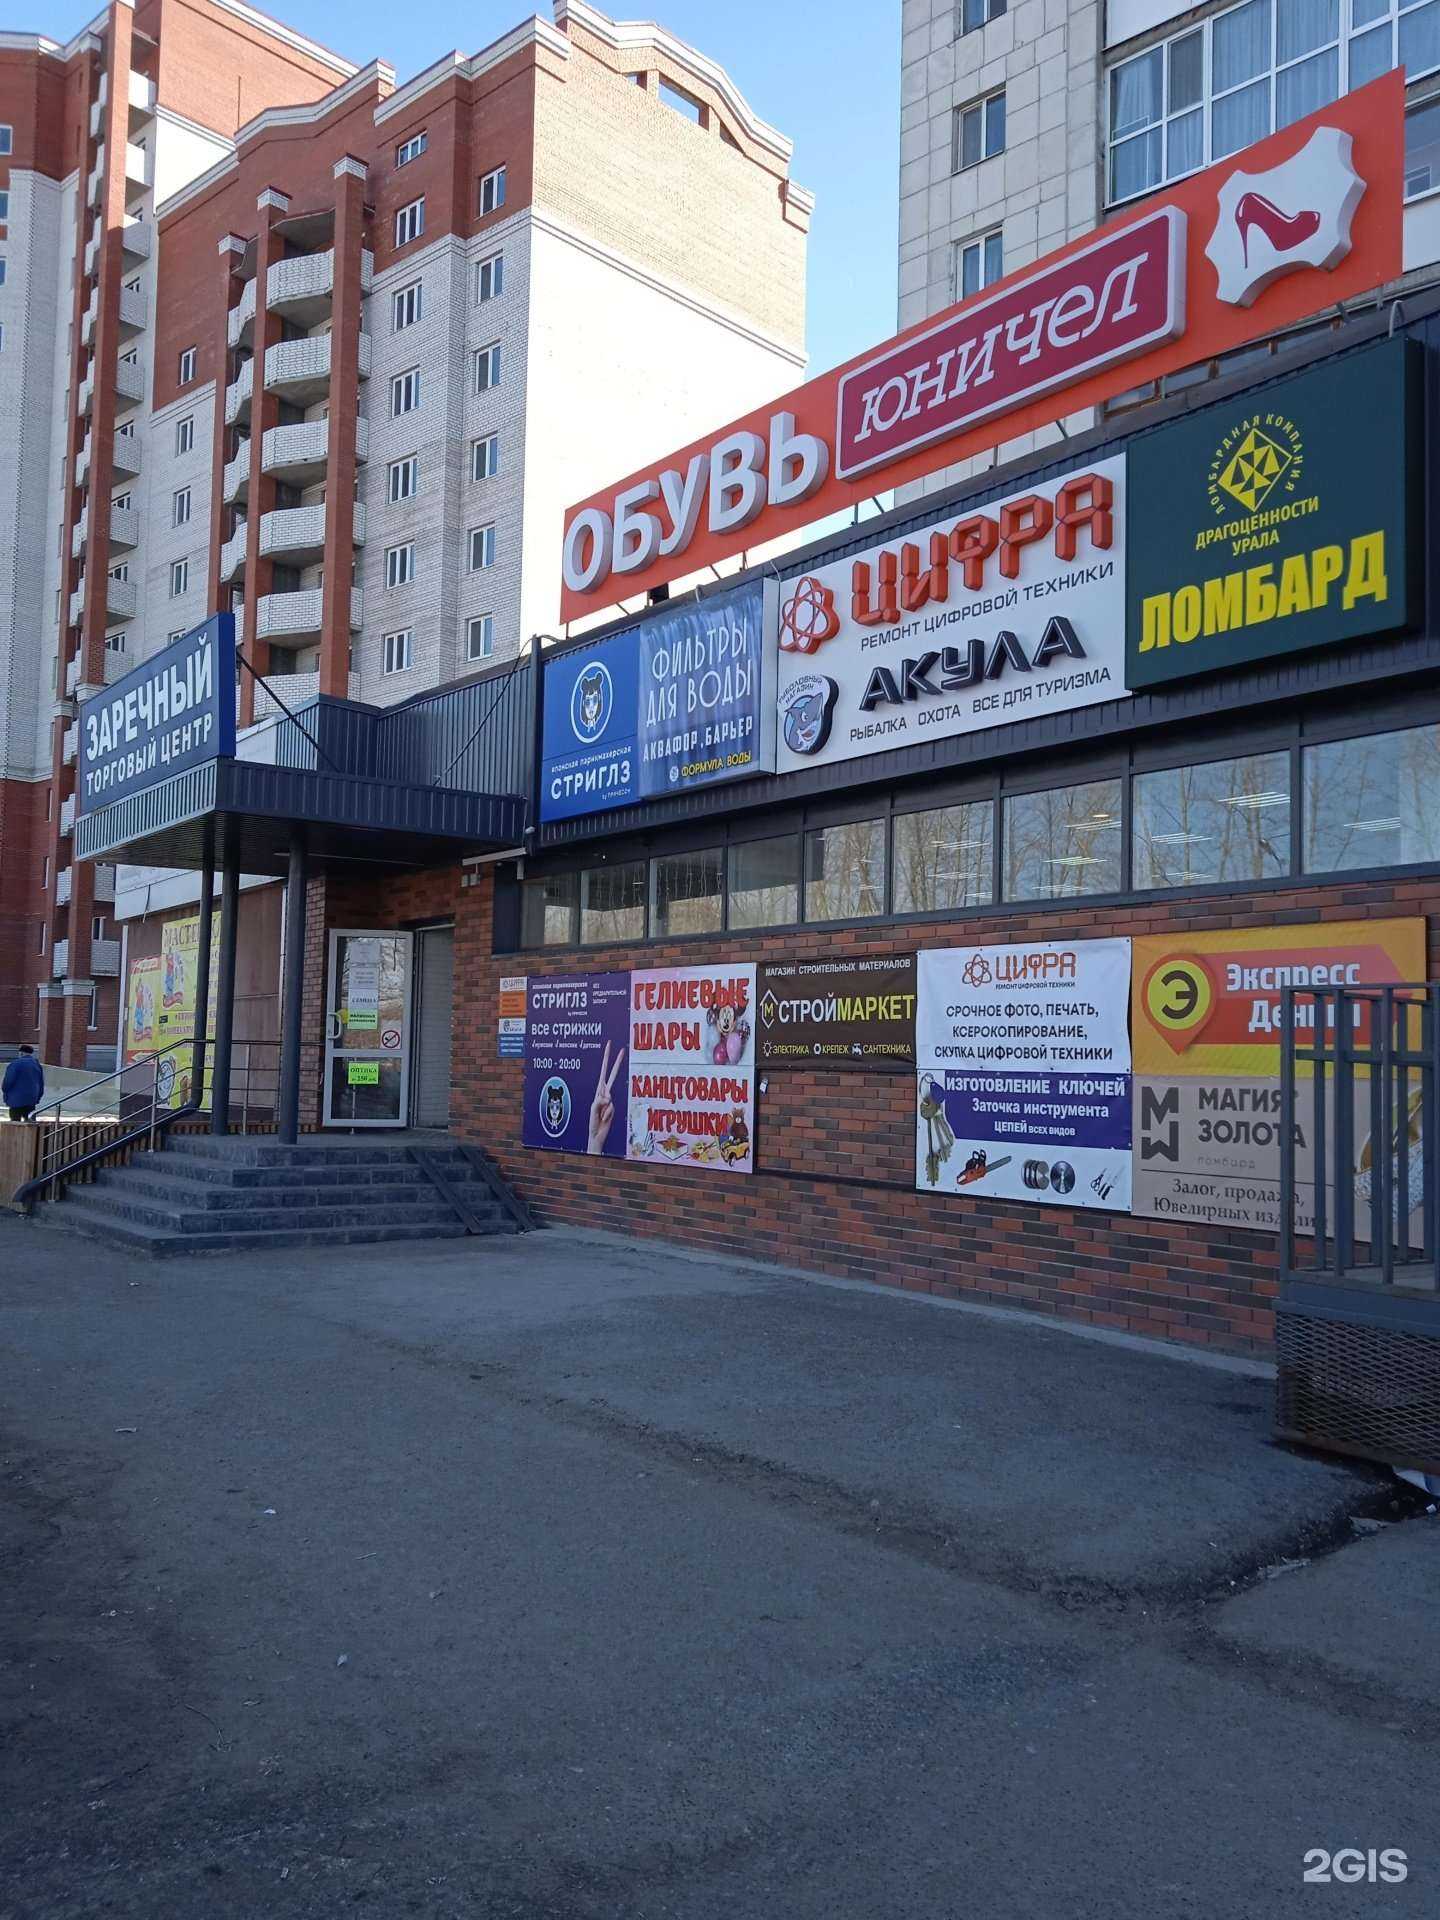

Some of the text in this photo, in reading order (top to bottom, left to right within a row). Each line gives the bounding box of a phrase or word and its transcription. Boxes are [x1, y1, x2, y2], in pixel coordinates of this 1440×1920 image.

[1208, 412, 1304, 515] ЛОМБАРДНАЯ КОМПАНИЯ
[563, 411, 829, 594] ОБУВЬ
[1195, 496, 1319, 551] ДРАГОЦЕННОСТИ
[851, 472, 1114, 626] ЦИФРА
[1232, 529, 1280, 556] УРАЛА
[1138, 529, 1388, 653] ЛОМБАРД
[860, 562, 1115, 651] РЕМОНТ ЦИФРОВОЙ ТЕХНИКИ
[651, 618, 748, 683] ФИЛЬТРЫ
[858, 614, 1087, 712] АКУЛА
[86, 632, 213, 761] ЗАРЕЧНЫЙ
[645, 658, 752, 728] ДЛЯ ВОДЫ
[849, 667, 1112, 742] РЫБАЛКА ОХОТА ВСЕ ДЛЯ ТУРИЗМА
[705, 715, 754, 745] БАРЬЕР
[86, 712, 213, 796] ТОРГОВЫЙ ЦЕНТР
[682, 751, 752, 777] ФОРМУЛА ВОДЫ
[551, 760, 631, 800] СТРИГЛЗ
[766, 959, 911, 976] МАГАЗИН СТРОИТЕЛЬНЫХ МАТЕРИАЛОВ
[996, 952, 1076, 982] ЦИФРА
[1226, 963, 1361, 991] Экспресс
[532, 992, 588, 1009] СТРИГЛЗ
[634, 978, 750, 1010] ГЕЛИЕВЫЕ
[778, 992, 915, 1023] СТРОЙМАРКЕТ
[946, 1003, 1099, 1019] СРОЧНОЕ ФОТО, ПЕЧАТЬ,
[531, 1023, 550, 1036] все
[552, 1022, 602, 1039] стрижки
[633, 1021, 701, 1051] ШАРЫ
[952, 1025, 1088, 1041] КСЕРОКОПИРОВАНИЕ,
[772, 1043, 911, 1054] ЭЛЕКТРИКА КРЕПЕЖ САНТЕХНИКА
[934, 1045, 1113, 1061] СКУПКА ЦИФРОВОЙ ТЕХНИКИ
[559, 1058, 581, 1070] 20:00
[631, 1074, 749, 1104] КАНЦТОВАРЫ
[946, 1077, 1125, 1097] ИЗГОТОВЛЕНИЕ КЛЮЧЕЙ
[647, 1108, 729, 1136] ИГРУШКИ
[972, 1098, 1109, 1119] Заточка инструмента
[994, 1120, 1027, 1133] ЦЕПЕЙ
[1172, 1178, 1220, 1198] Залог,
[1154, 1197, 1250, 1222] Ювелирных
